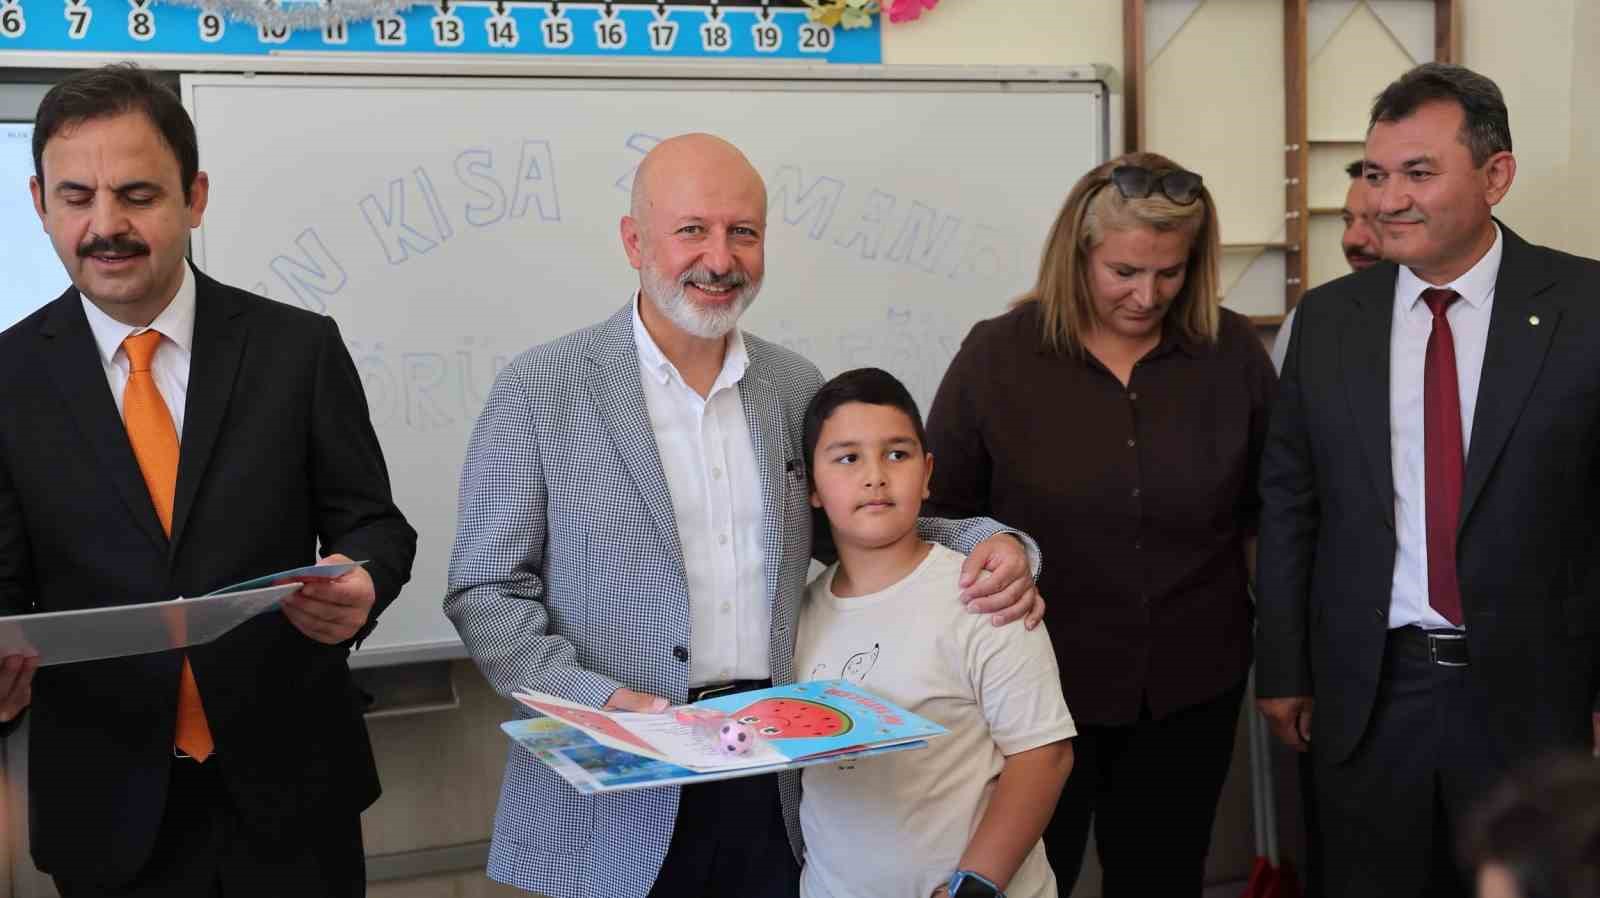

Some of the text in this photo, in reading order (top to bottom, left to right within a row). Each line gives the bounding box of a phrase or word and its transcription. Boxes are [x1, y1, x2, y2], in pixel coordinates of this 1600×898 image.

[2, 9, 21, 33] 6
[70, 11, 87, 34] 7
[133, 12, 150, 36] 8
[203, 14, 220, 37] 9
[326, 21, 343, 40] 11
[376, 18, 401, 41] 12
[436, 20, 460, 42] 13
[490, 21, 513, 43] 14
[545, 23, 569, 44] 15
[599, 23, 623, 45] 16
[652, 25, 674, 46] 17
[705, 26, 727, 47] 18
[756, 27, 778, 48] 19
[803, 27, 831, 49] 20
[250, 228, 347, 314] N
[358, 138, 560, 265] KISA
